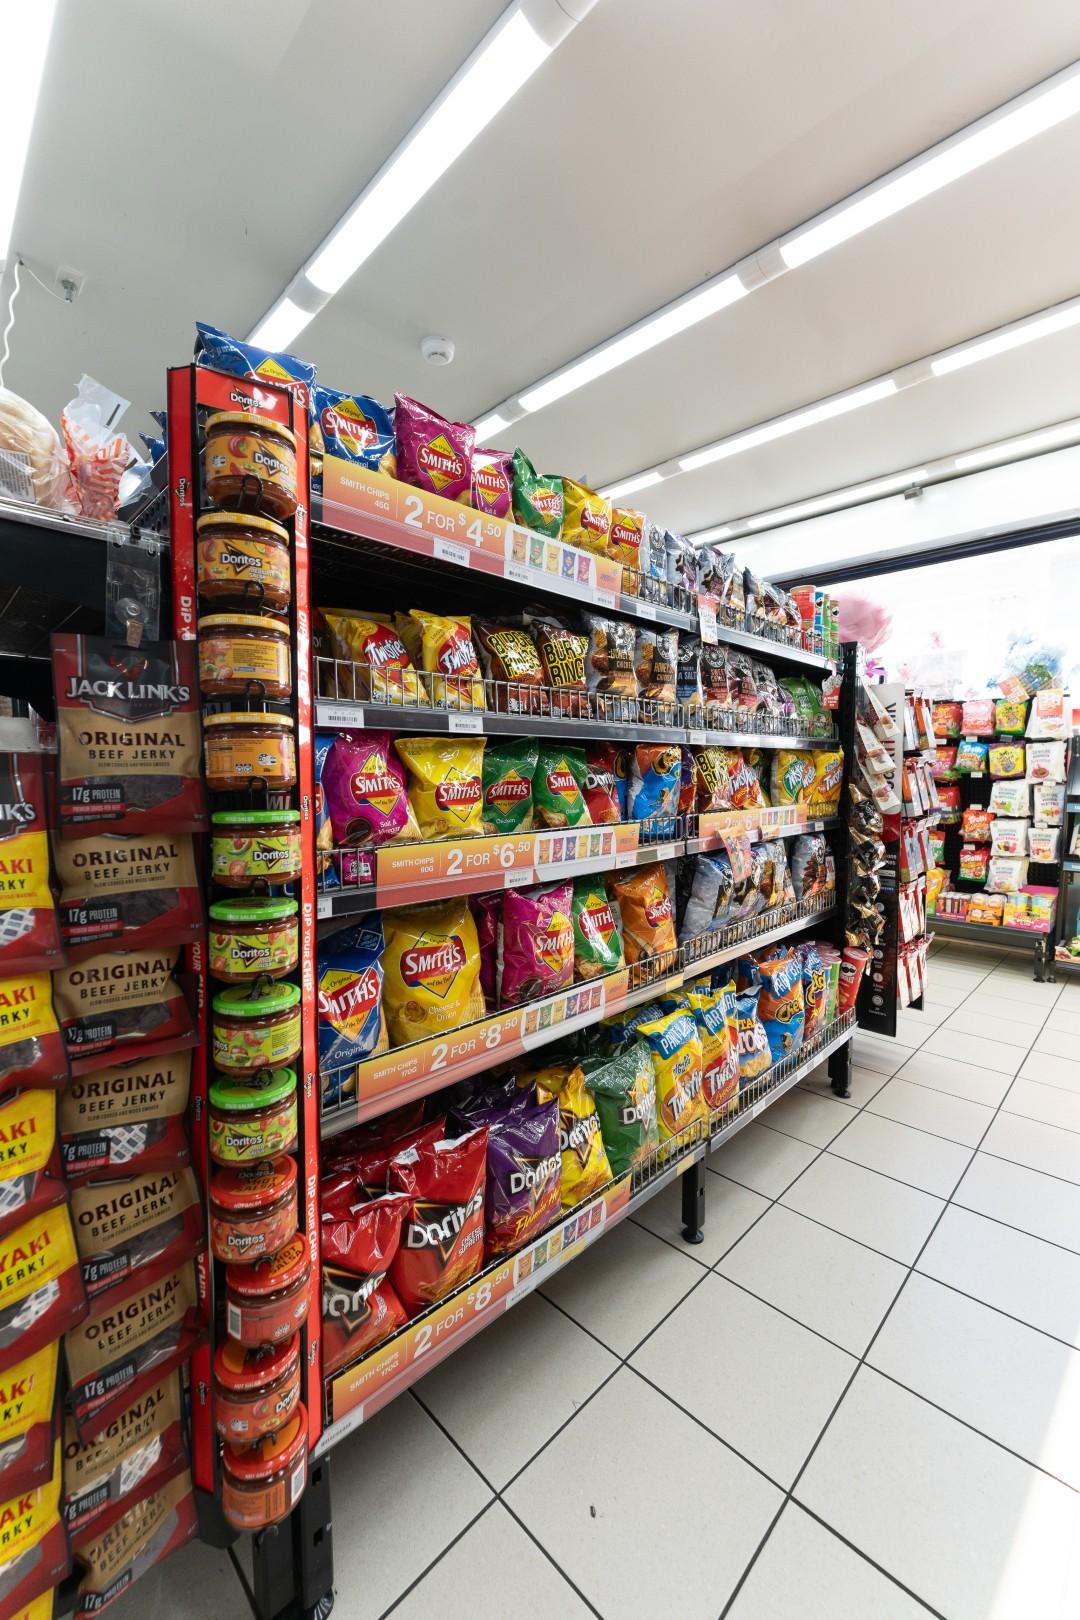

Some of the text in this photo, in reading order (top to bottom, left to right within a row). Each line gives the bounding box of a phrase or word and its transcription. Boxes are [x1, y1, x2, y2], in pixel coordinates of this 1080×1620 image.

[254, 452, 289, 474] Doritos
[420, 448, 463, 476] SMITH'S
[340, 477, 390, 500] SMITH CHIPS
[404, 495, 501, 547] 2 FOR $4.50
[613, 526, 641, 544] SMITH'S
[221, 554, 262, 567] Doritos
[550, 658, 584, 687] RING
[67, 677, 190, 702] JACK LINK'S
[79, 732, 186, 747] ORIGINAL
[89, 750, 176, 759] BEEF JERKY
[72, 787, 120, 803] 17g PROTEIN
[356, 776, 400, 795] SMITH'S
[440, 784, 480, 802] SMITH'S
[489, 782, 528, 798] SMITH'S
[72, 844, 178, 867] ORIGINAL
[254, 850, 289, 860] Doritos
[392, 857, 433, 868] SMITH CHIPS
[447, 841, 531, 875] 2 FOR $6.50
[85, 862, 171, 881] BEEF JERKY
[69, 907, 118, 924] 17g PROTEIN
[232, 948, 270, 958] Doritos
[405, 944, 462, 975] SMITH'S
[69, 959, 172, 986] ORIGINAL
[80, 984, 116, 999] BEEF
[124, 977, 166, 993] JERKY
[1, 1008, 30, 1025] RKY
[85, 1025, 112, 1040] PROTEIN
[430, 1017, 518, 1071] 2 FOR $8.50
[373, 1058, 418, 1080] SMITH CHIPS
[71, 1071, 175, 1100] ORIGINAL
[79, 1100, 115, 1114] BEEF
[122, 1090, 166, 1107] JERKY
[63, 1142, 107, 1161] 7g PROTEIN
[226, 1135, 263, 1146] Doritos
[510, 1152, 561, 1194] Doritos
[78, 1172, 180, 1226] ORIGINAL
[91, 1215, 126, 1237] BEEF
[134, 1192, 175, 1219] JERKY
[407, 1187, 483, 1248] Doritos
[228, 1234, 264, 1245] Doritos
[83, 1256, 128, 1280] 7g PROTEIN
[85, 1275, 181, 1340] ORIGINAL
[140, 1296, 177, 1327] JERKY
[413, 1268, 510, 1359] 2 FOR $8.50
[85, 1364, 134, 1399] 17g PROTEIN
[350, 1352, 399, 1392] SMITH CHIPS
[79, 1487, 108, 1511] PROTEIN
[2, 1516, 33, 1544] RKY
